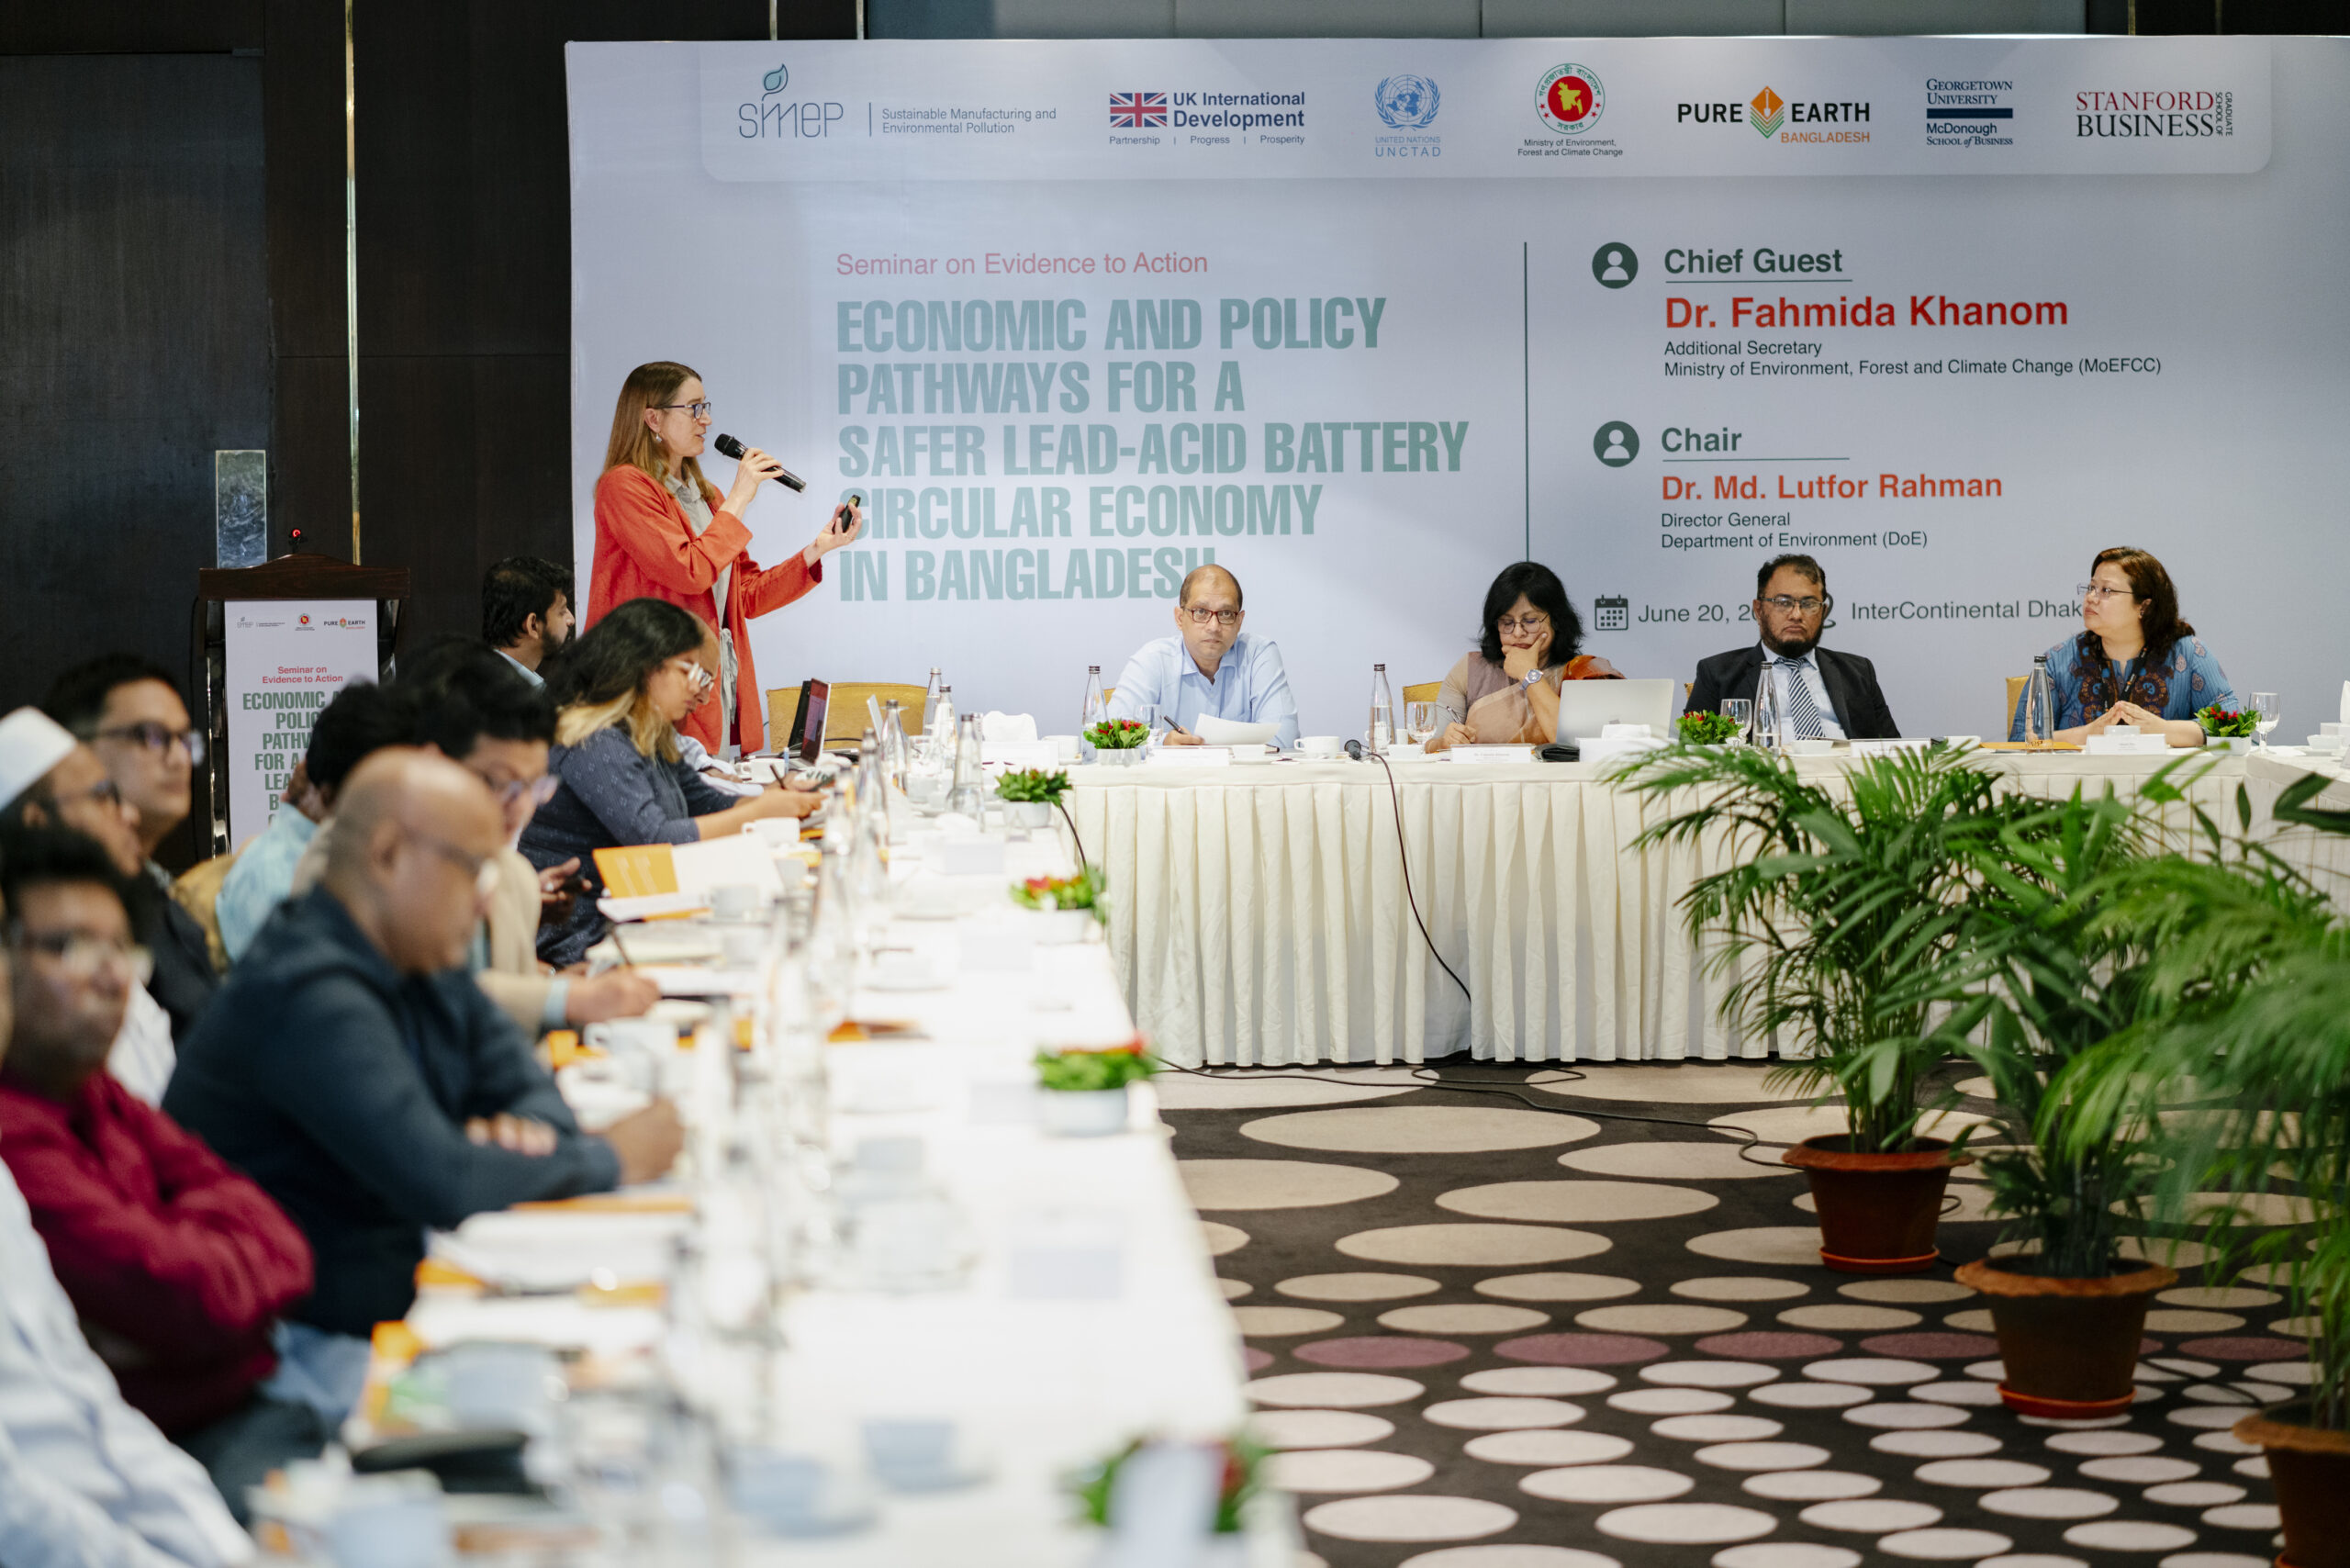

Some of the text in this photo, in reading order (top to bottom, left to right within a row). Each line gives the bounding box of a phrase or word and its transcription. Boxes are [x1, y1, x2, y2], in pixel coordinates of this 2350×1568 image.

[1174, 92, 1304, 106] UK International
[2077, 92, 2213, 110] STANFORD
[882, 107, 1056, 123] Sustainable Manufacturing and
[1174, 110, 1304, 130] Development
[1678, 103, 1869, 123] PURE EARTH
[883, 122, 1014, 133] Environmental Pollution
[1927, 123, 1997, 136] McDonough
[2077, 114, 2213, 137] BUSINESS
[2216, 126, 2222, 136] OF
[1110, 135, 1304, 146] Partnership Progress Prosperity
[1525, 140, 1553, 148] Ministry
[1566, 139, 1616, 149] Environment,
[1781, 131, 1870, 143] BANGLADESH
[1964, 136, 1973, 148] of
[1375, 146, 1440, 157] UNCTAD
[1594, 149, 1623, 157] Change
[837, 252, 1207, 275] Seminar on Evidence to Action
[1665, 248, 1842, 274] Chief Guest
[1667, 296, 2067, 328] Dr. Fahmida Khanom
[837, 297, 1387, 353] ECONOMIC AND POLICY
[1664, 341, 1821, 357] Additional Secretary
[1665, 357, 2161, 379] Ministry of Environment, Forest and Climate Change (MoEFCC)
[838, 361, 1245, 415] PATHWAYS FOR A
[1662, 427, 1741, 452] Chair
[839, 421, 1469, 477] SAFER LEAD-ACID BATTERY
[1663, 474, 2001, 500] Dr. Md. Lutfor Rahman
[1090, 484, 1323, 536] ECONOMY
[1662, 512, 1790, 527] Director General
[1662, 532, 1927, 551] Department of Environment (DoE)
[839, 551, 888, 601] IN
[1639, 605, 1689, 622] June
[1698, 605, 1729, 623] 20,
[1852, 600, 2082, 620] InterContinental Dhak
[315, 675, 343, 683] Action
[242, 691, 326, 710] ECONOMIC
[255, 753, 285, 770] FOR
